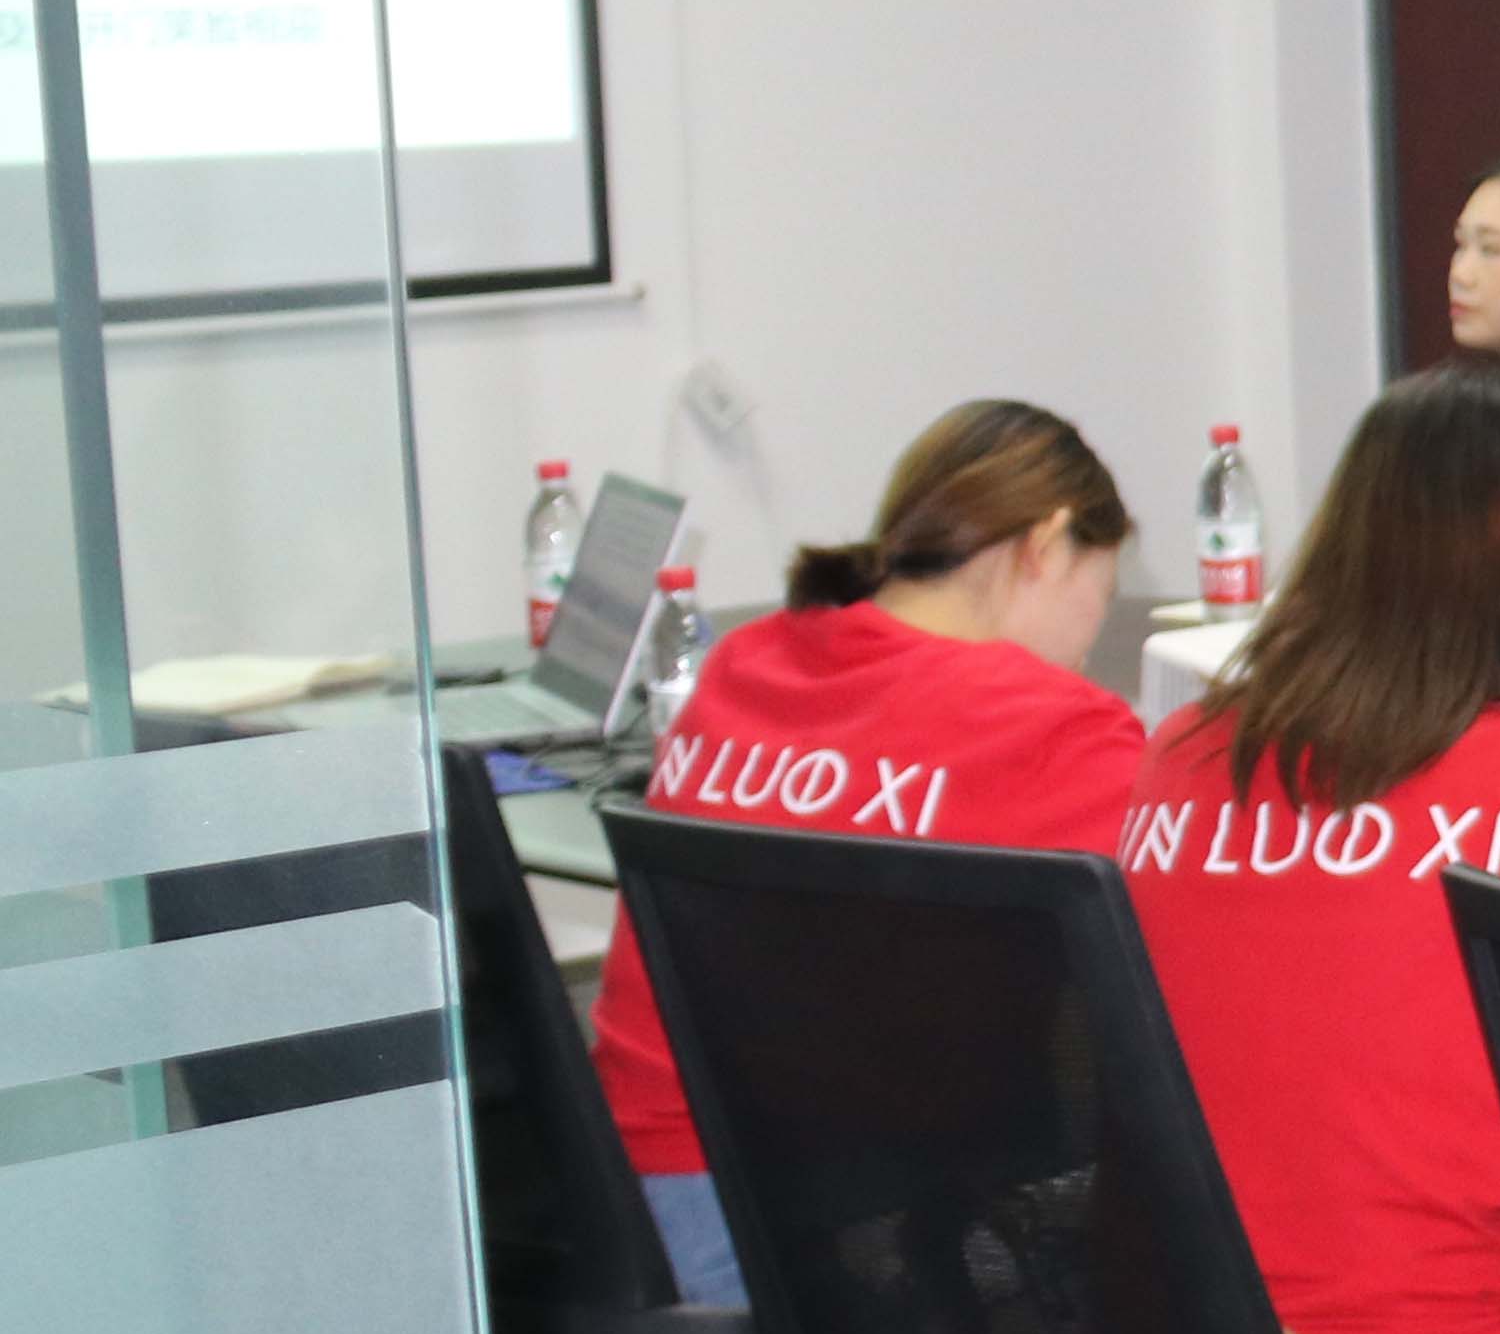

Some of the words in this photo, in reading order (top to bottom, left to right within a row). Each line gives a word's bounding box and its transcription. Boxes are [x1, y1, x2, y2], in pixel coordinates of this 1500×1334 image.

[695, 736, 850, 816] LUO
[851, 755, 947, 837] XI
[1201, 799, 1396, 878] LUO
